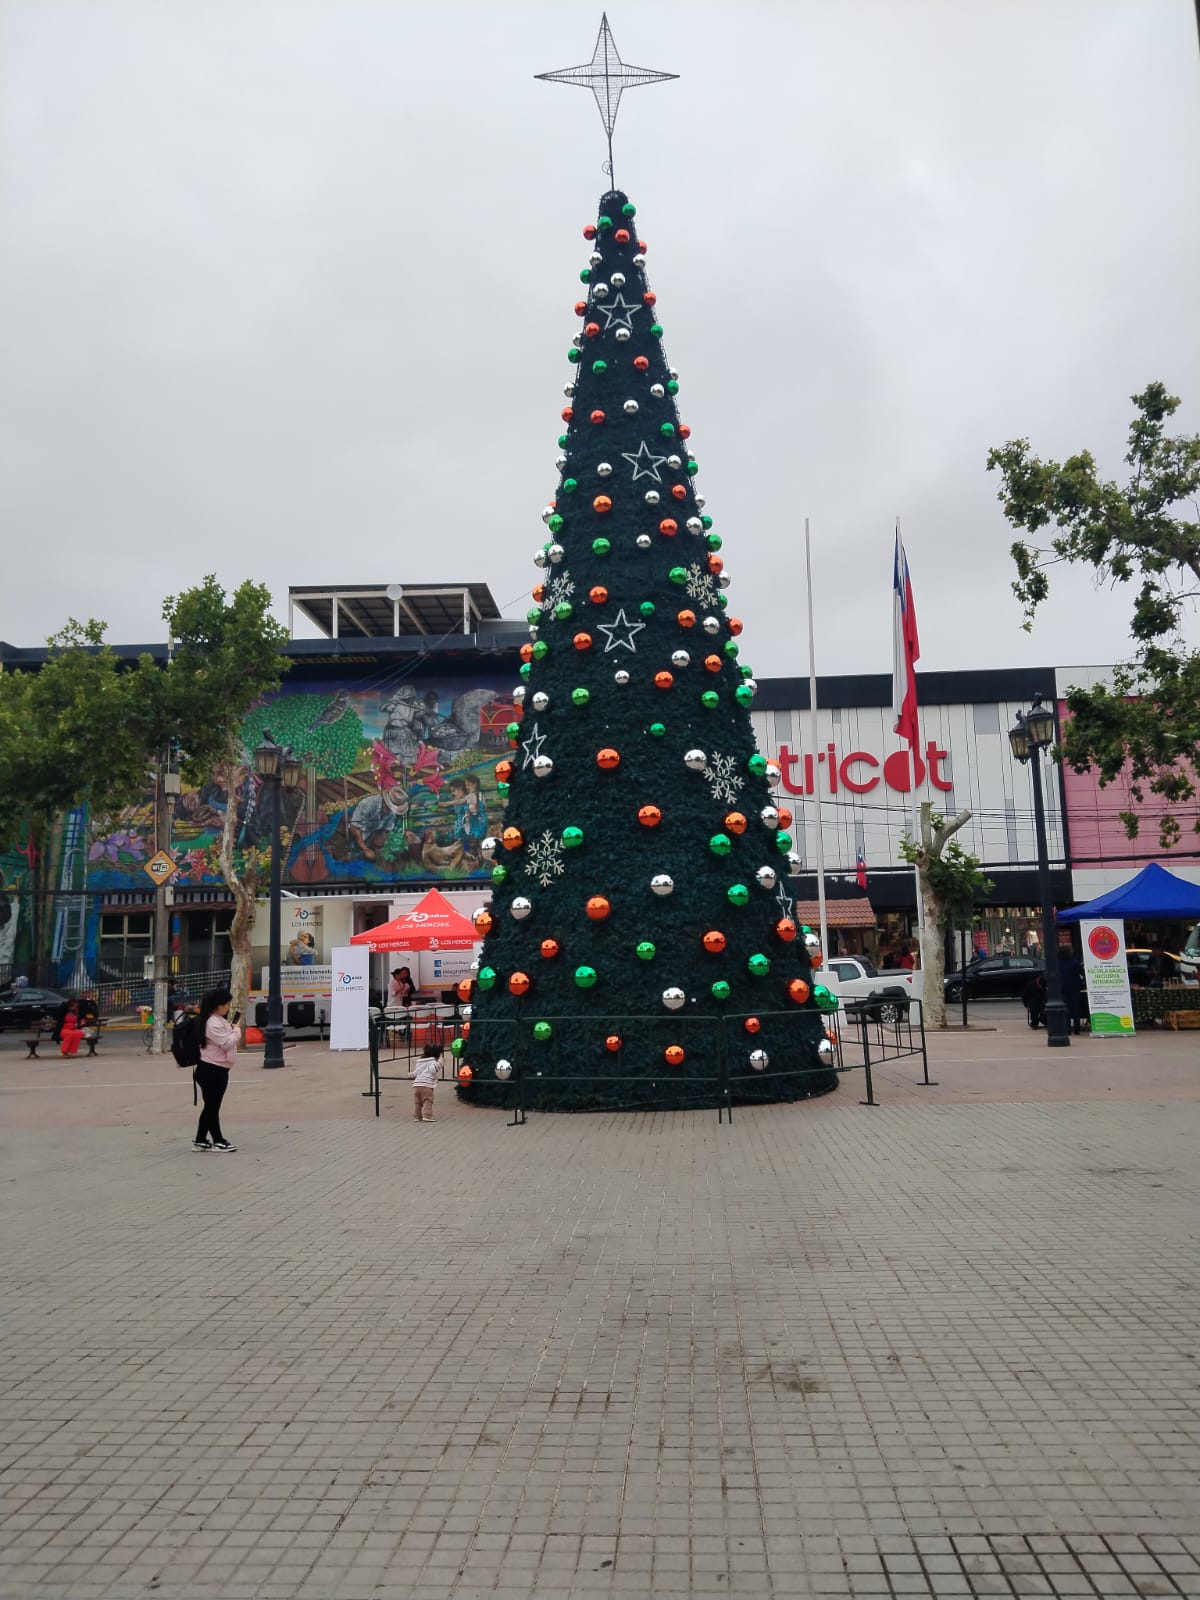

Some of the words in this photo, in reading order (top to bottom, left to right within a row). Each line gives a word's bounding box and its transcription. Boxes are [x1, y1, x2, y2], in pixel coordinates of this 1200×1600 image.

[779, 741, 953, 795] tricot
[405, 911, 429, 923] 70
[338, 972, 352, 984] 70
